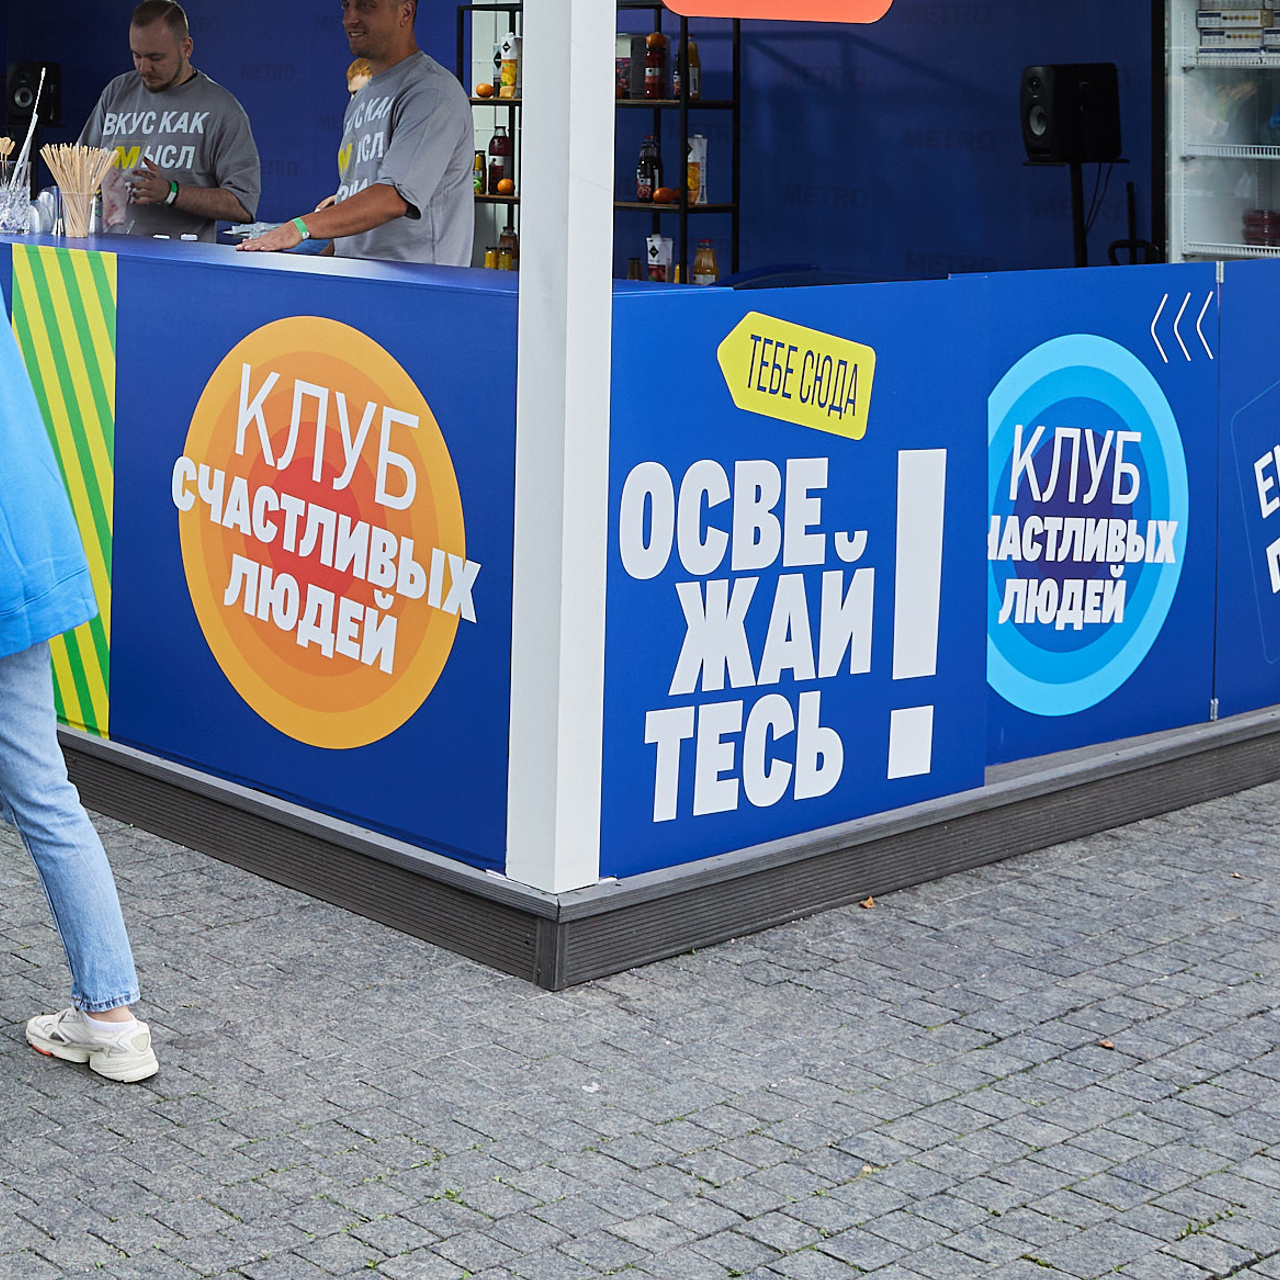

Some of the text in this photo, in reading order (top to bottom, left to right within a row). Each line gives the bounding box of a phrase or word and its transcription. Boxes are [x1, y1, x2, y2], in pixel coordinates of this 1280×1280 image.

[103, 111, 210, 136] ВКУС КАК
[103, 145, 195, 170] МЫСЛ
[235, 363, 419, 510] КЛУБ
[747, 334, 859, 420] ТЕБЕ СЮДА
[620, 458, 829, 580] ОСВЕ
[1009, 425, 1142, 505] КЛУБ
[172, 456, 481, 624] СЧАСТЛИВЫХ
[999, 565, 1126, 630] ЛЮДЕЙ
[224, 554, 398, 674] ЛЮДЕЙ
[669, 531, 875, 696] ЖАЙ
[644, 691, 844, 823] ТЕСЬ
